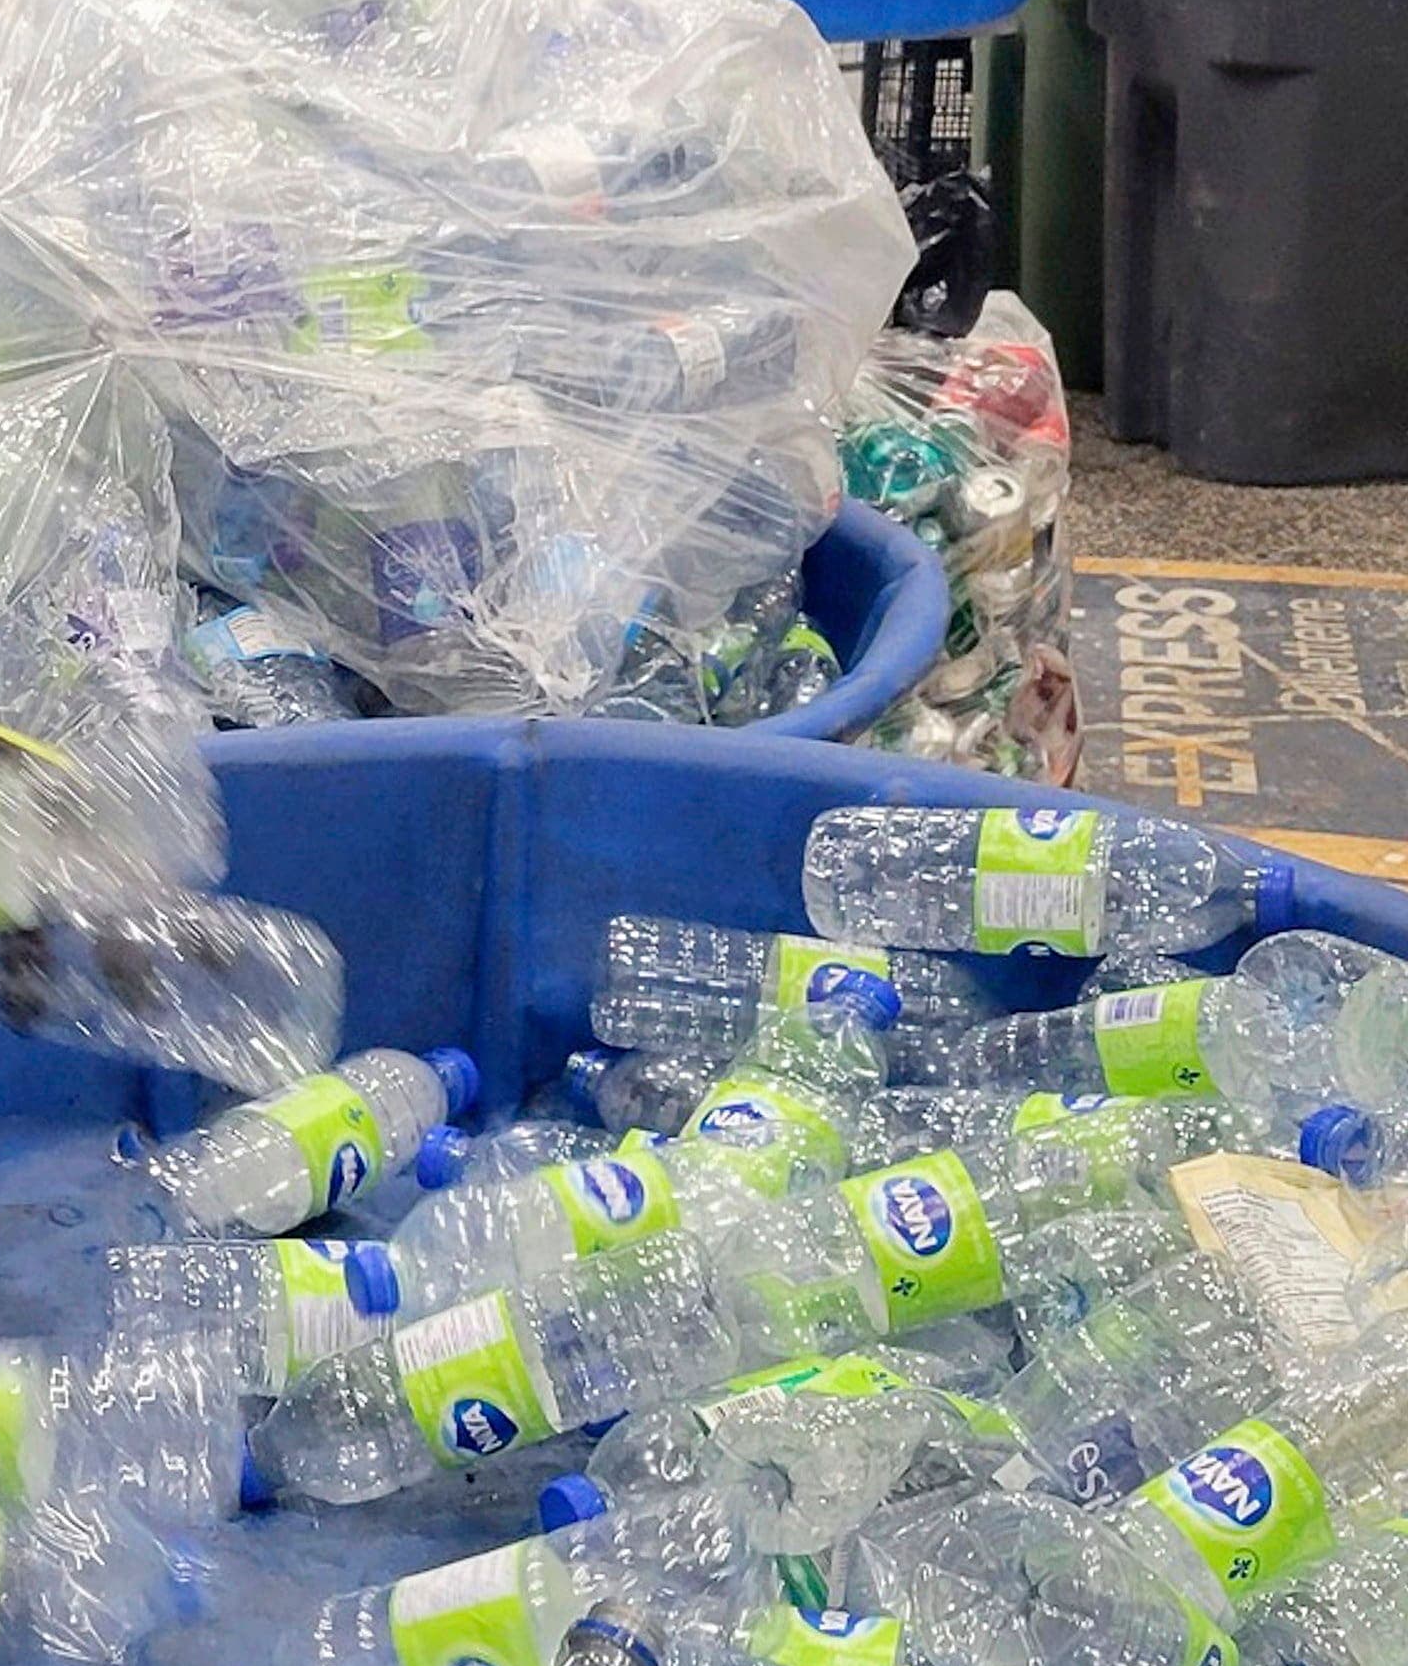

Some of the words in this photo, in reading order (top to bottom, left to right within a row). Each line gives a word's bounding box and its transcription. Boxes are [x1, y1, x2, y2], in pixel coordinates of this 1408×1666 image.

[1114, 585, 1258, 796] EXPRESS
[891, 1179, 939, 1252] NAYA
[1187, 1453, 1261, 1521] NAYA
